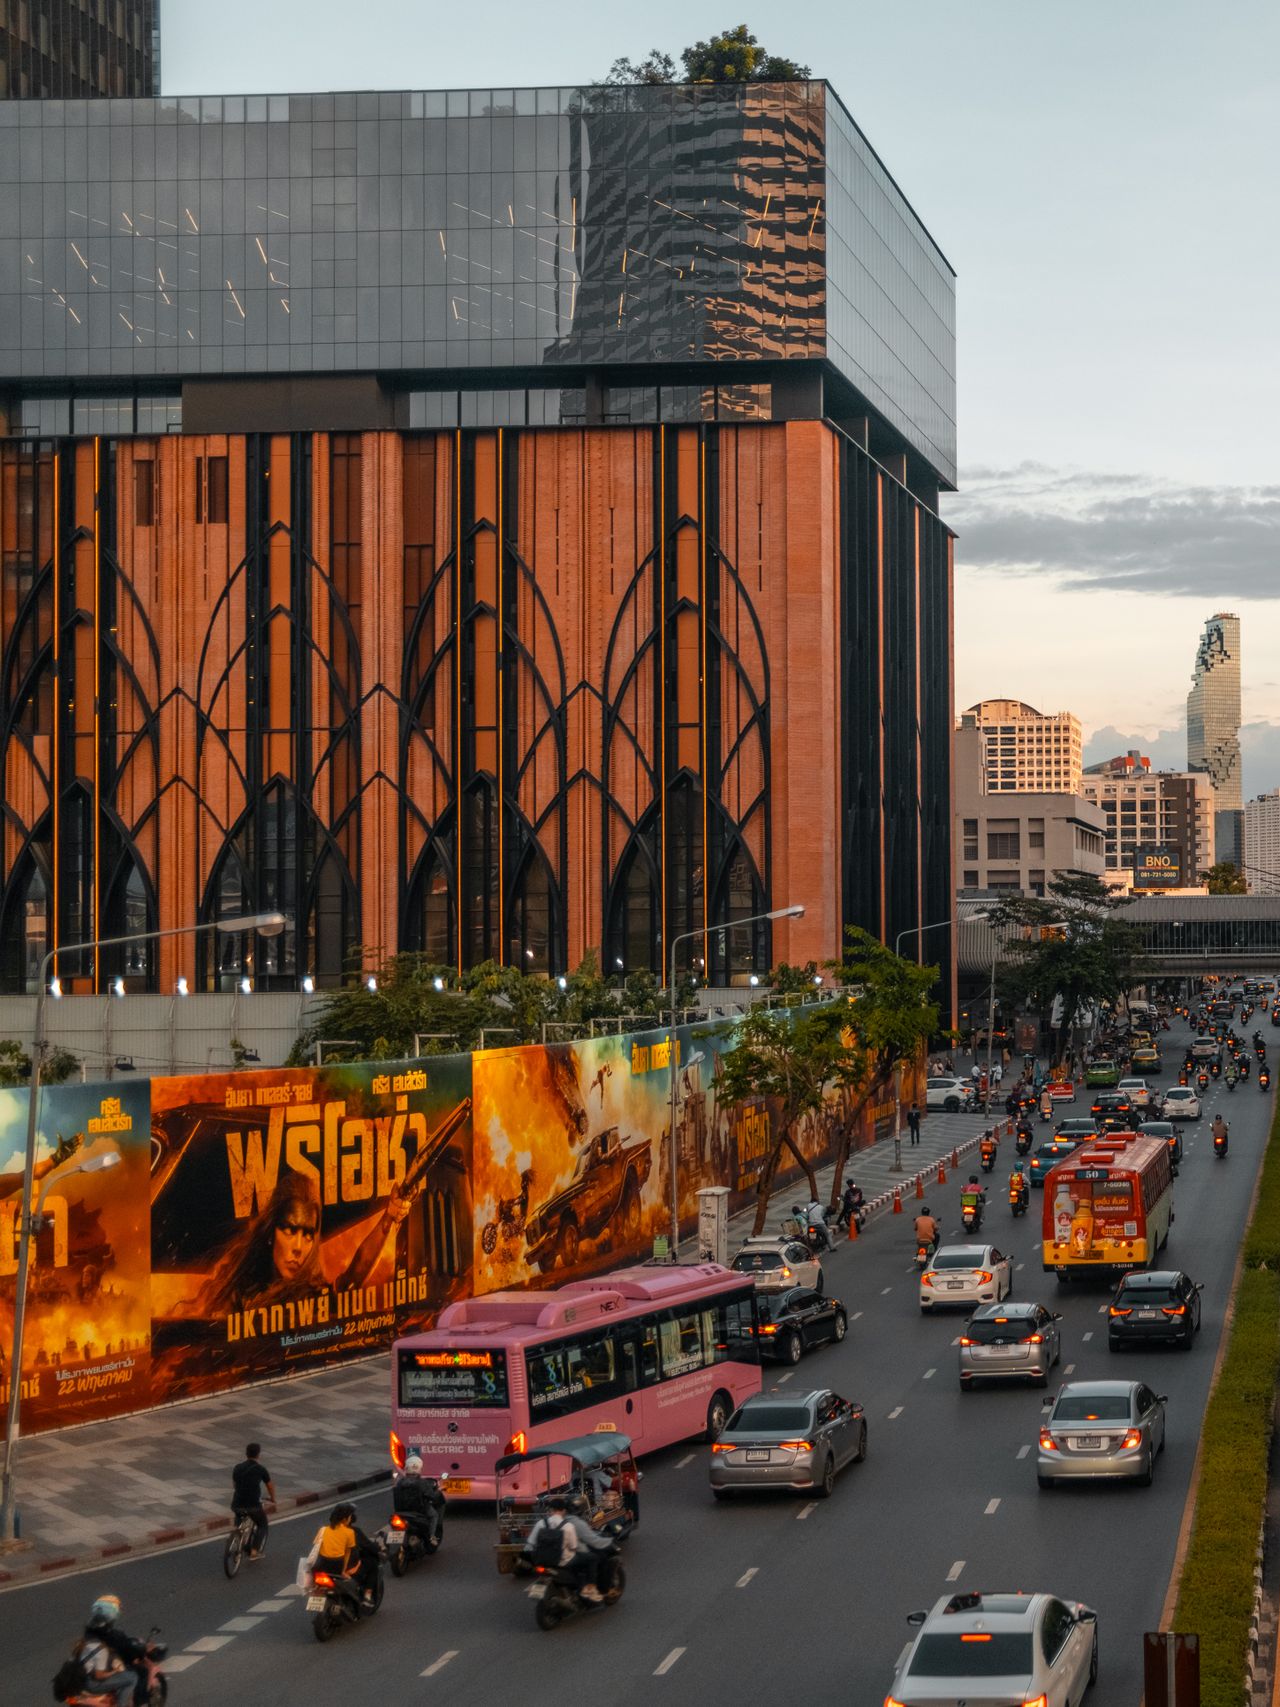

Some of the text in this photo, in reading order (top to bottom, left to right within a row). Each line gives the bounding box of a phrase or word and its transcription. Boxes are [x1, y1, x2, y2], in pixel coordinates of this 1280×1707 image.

[1145, 856, 1171, 867] BNO
[1086, 1170, 1099, 1179] 50
[601, 1296, 620, 1312] NEX
[227, 1288, 330, 1342] มหากาพย์
[344, 1321, 357, 1336] 22
[58, 1379, 76, 1396] 22
[421, 1445, 487, 1454] ELECTRIC BUS
